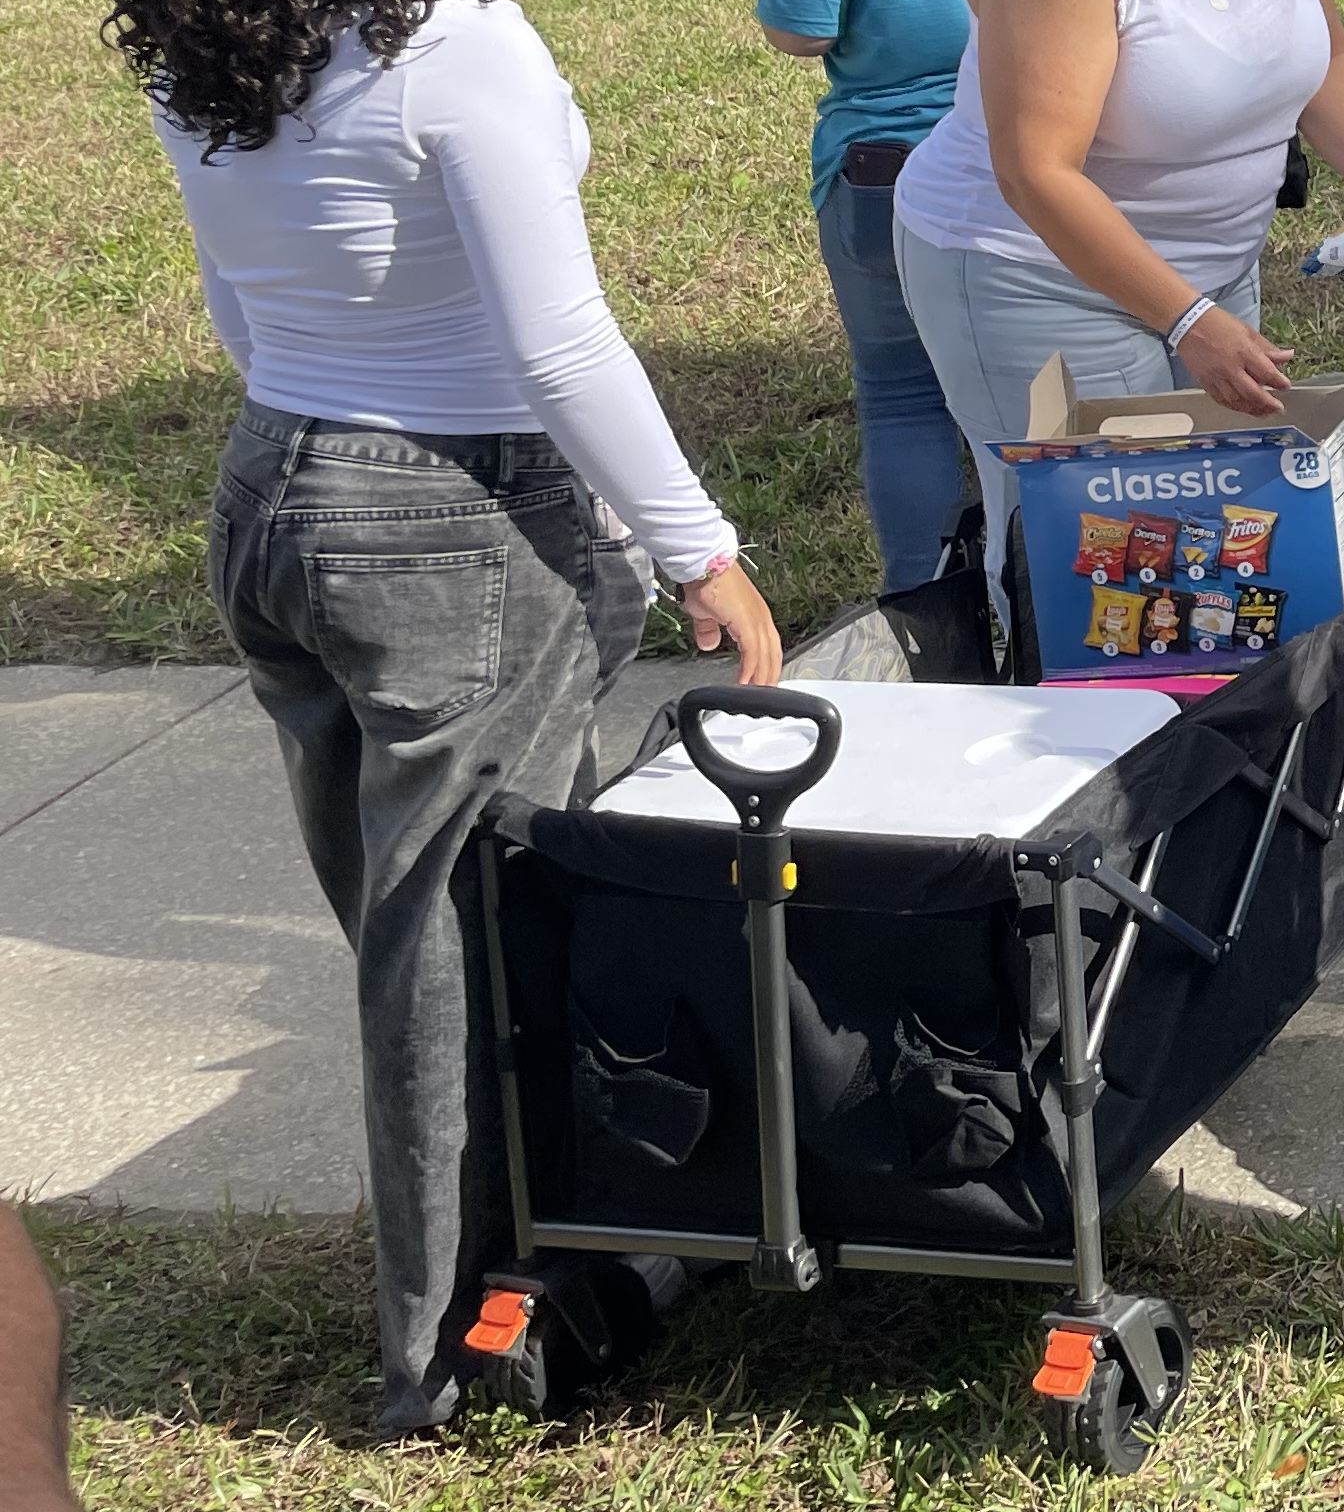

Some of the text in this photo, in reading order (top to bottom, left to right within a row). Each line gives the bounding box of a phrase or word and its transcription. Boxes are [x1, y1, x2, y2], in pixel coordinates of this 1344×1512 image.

[1293, 451, 1319, 472] 28
[1087, 460, 1243, 504] classic
[1227, 518, 1267, 539] Fritos
[1193, 568, 1200, 578] 2
[1242, 565, 1249, 574] 4
[1252, 638, 1258, 647] 2
